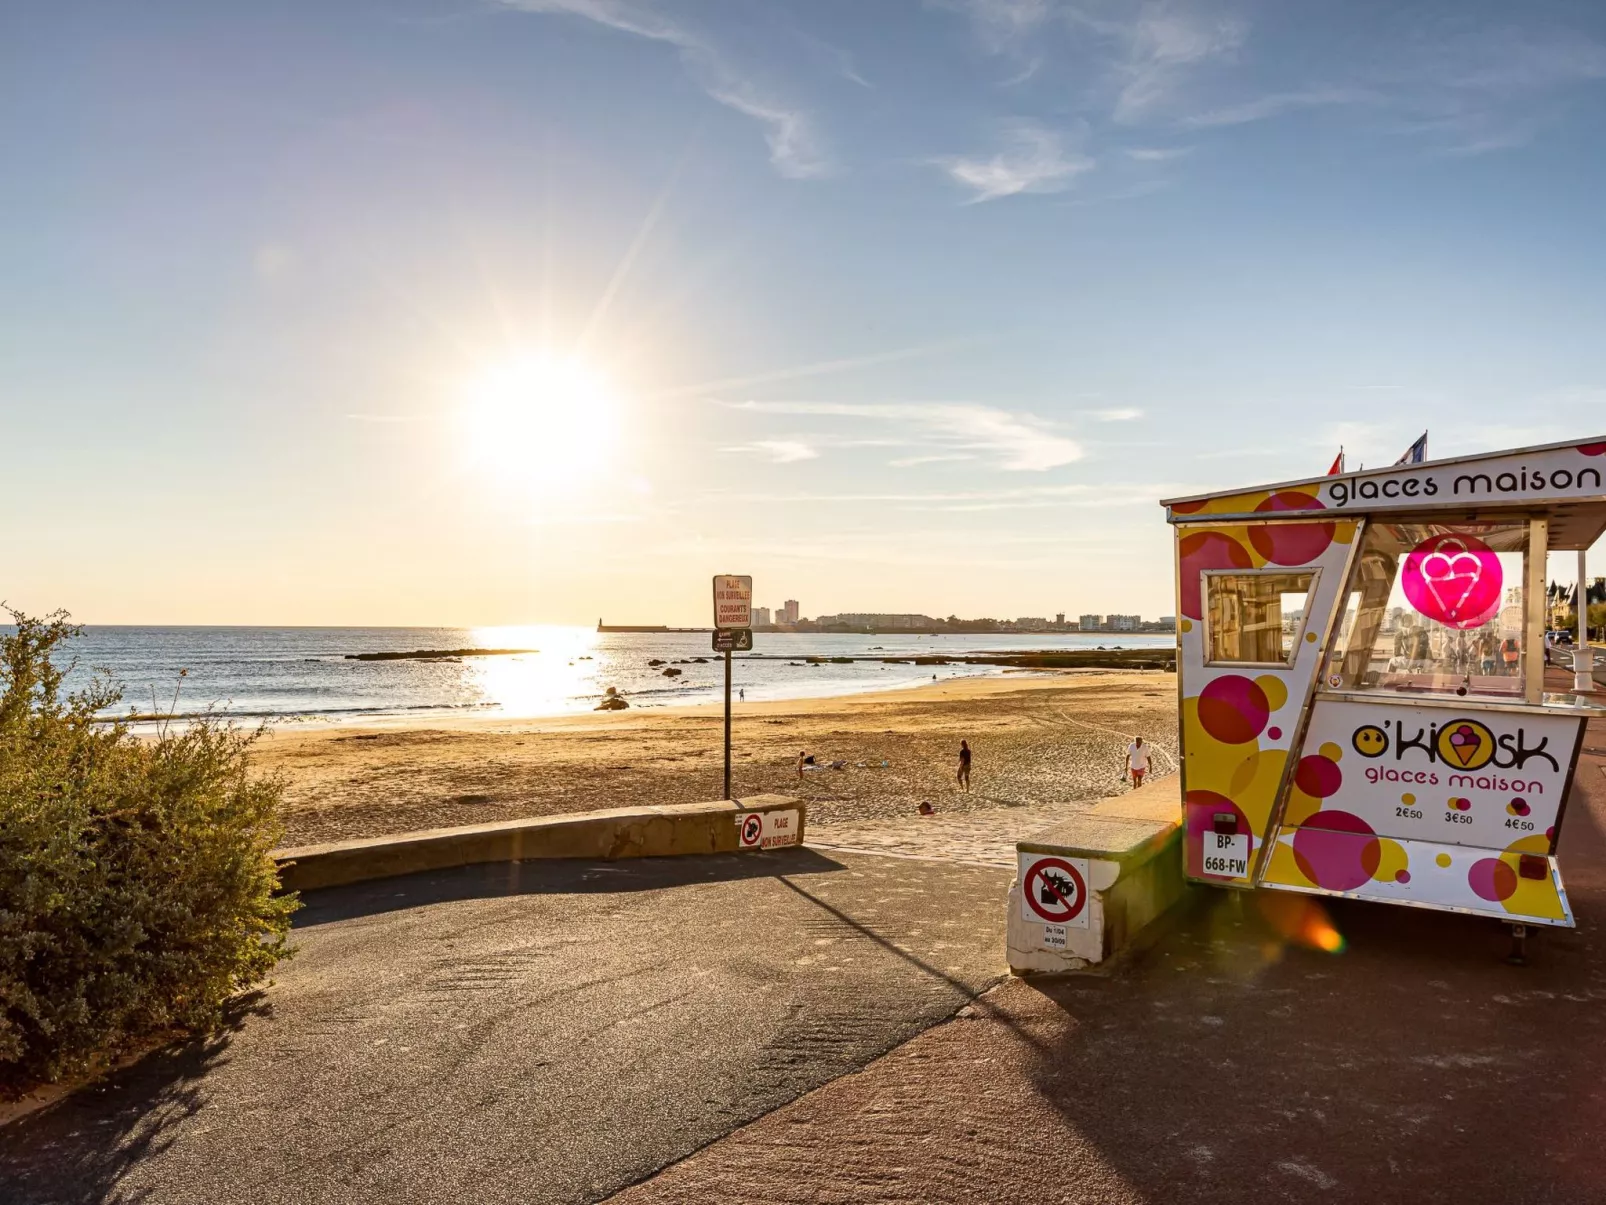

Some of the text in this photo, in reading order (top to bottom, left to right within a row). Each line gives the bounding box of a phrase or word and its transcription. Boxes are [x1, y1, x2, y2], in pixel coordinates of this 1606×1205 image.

[1329, 466, 1601, 507] glaces maison
[726, 580, 740, 589] PLAGE
[720, 604, 747, 613] COURANTS
[719, 614, 749, 623] DANGEREUX
[1365, 765, 1544, 794] glaces maison
[1395, 807, 1423, 819] 2€50
[1444, 811, 1473, 825] 3€50
[774, 817, 788, 829] PLAGE
[1504, 818, 1535, 831] 4€50
[761, 836, 771, 848] NON
[1217, 835, 1235, 849] BP-
[1205, 856, 1246, 874] 668-FW
